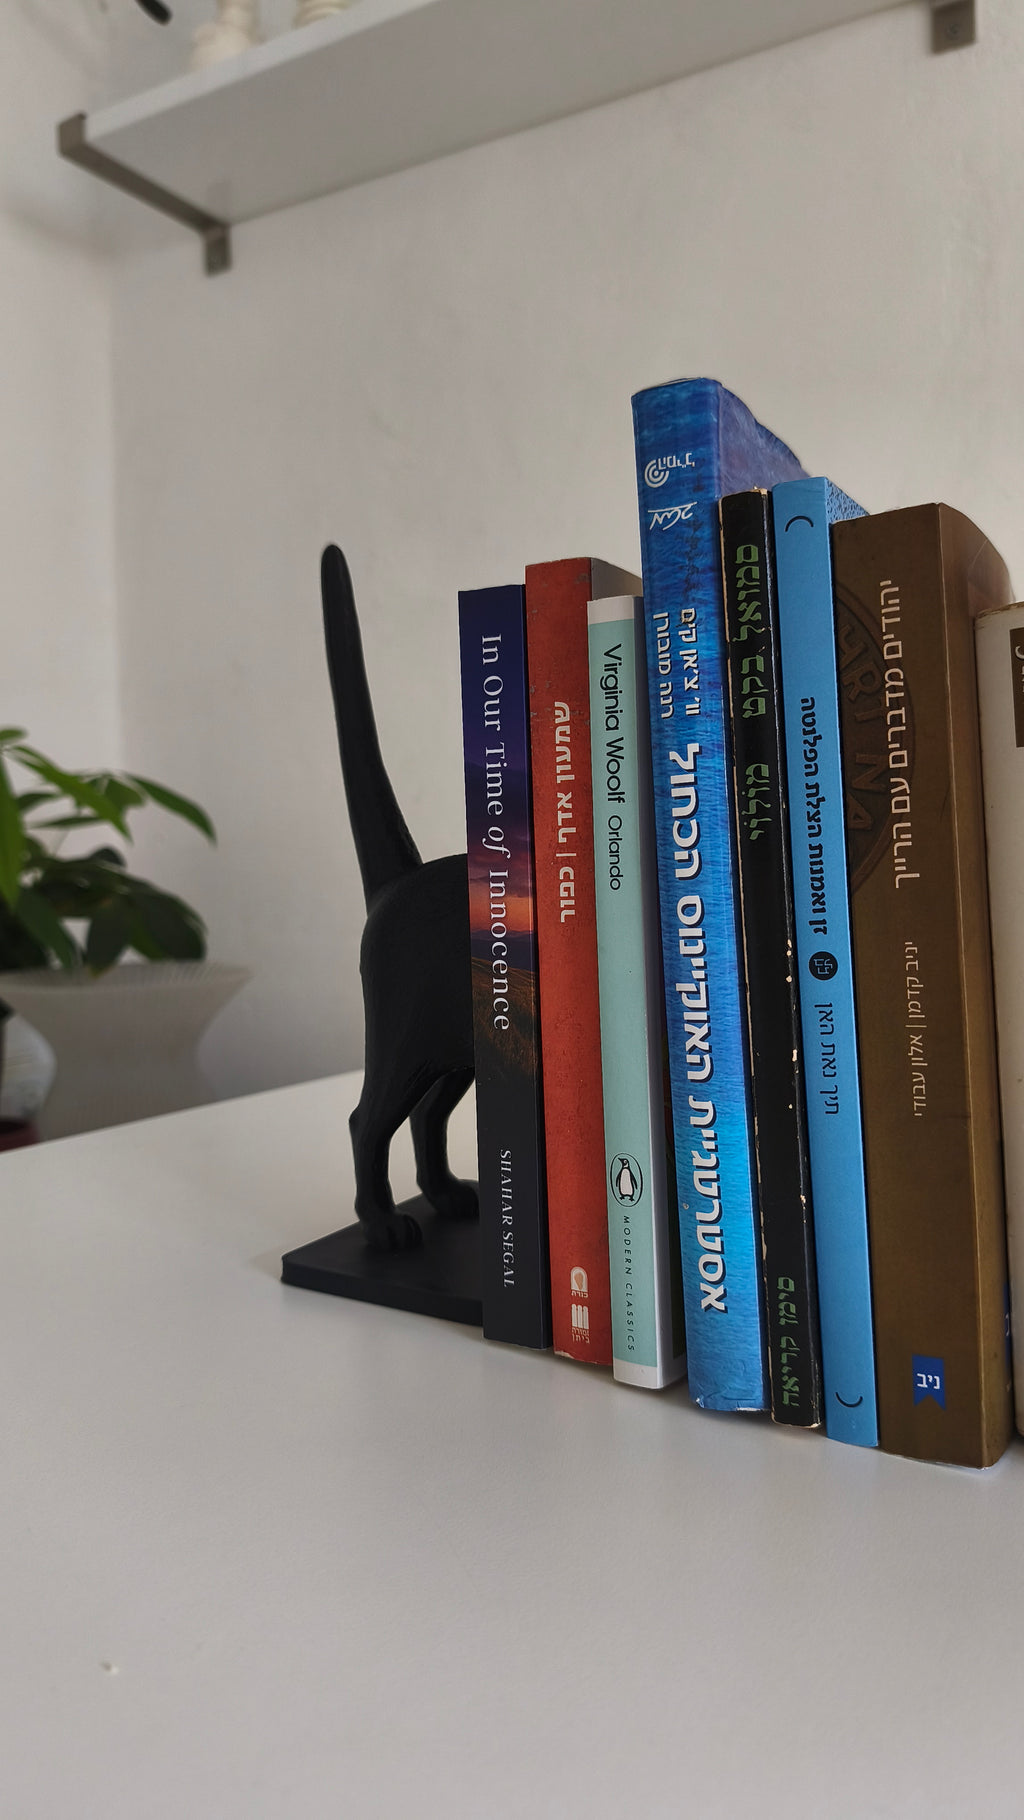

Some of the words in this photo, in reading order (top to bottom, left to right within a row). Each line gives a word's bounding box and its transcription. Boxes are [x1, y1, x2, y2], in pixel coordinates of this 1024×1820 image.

[732, 543, 763, 643] סמואל
[879, 579, 902, 660] יהודים
[482, 634, 501, 665] In
[653, 612, 671, 675] מובורן
[678, 607, 697, 643] קים
[483, 675, 504, 732] Our
[600, 643, 623, 731] Virginia
[660, 681, 674, 719] רנה
[741, 656, 768, 718] בקט
[554, 701, 575, 784] שמעון
[799, 696, 822, 777] הפלנטה
[884, 667, 908, 768] מדברים
[485, 742, 508, 816] Time
[605, 737, 626, 804] Woolf
[889, 776, 911, 813] עם
[556, 792, 577, 843] אדף
[669, 741, 702, 880] הכחול
[804, 782, 826, 838] הצלת
[482, 826, 511, 859] of
[608, 814, 624, 891] Orlando
[892, 822, 920, 888] הרייך
[559, 866, 576, 923] כפור
[807, 843, 828, 914] ואמנות
[489, 869, 510, 1030] Innocence
[809, 918, 829, 936] זן
[904, 940, 919, 971] יניב
[676, 894, 712, 1084] האוקיינוס
[814, 1002, 835, 1035] האן
[905, 976, 926, 1019] קדמן
[820, 1042, 838, 1077] נאת
[907, 1034, 928, 1067] אלון
[819, 1085, 840, 1115] תיך
[911, 1071, 927, 1117] עבודי
[500, 1149, 513, 1225] SHAHAR
[689, 1094, 727, 1313] אסטרטגיית
[502, 1230, 515, 1287] SEGAL
[623, 1215, 633, 1275] MODERN
[625, 1282, 635, 1352] CLASSICS
[777, 1276, 799, 1326] סימן
[779, 1336, 801, 1407] קריאה
[916, 1372, 941, 1390] ניב
